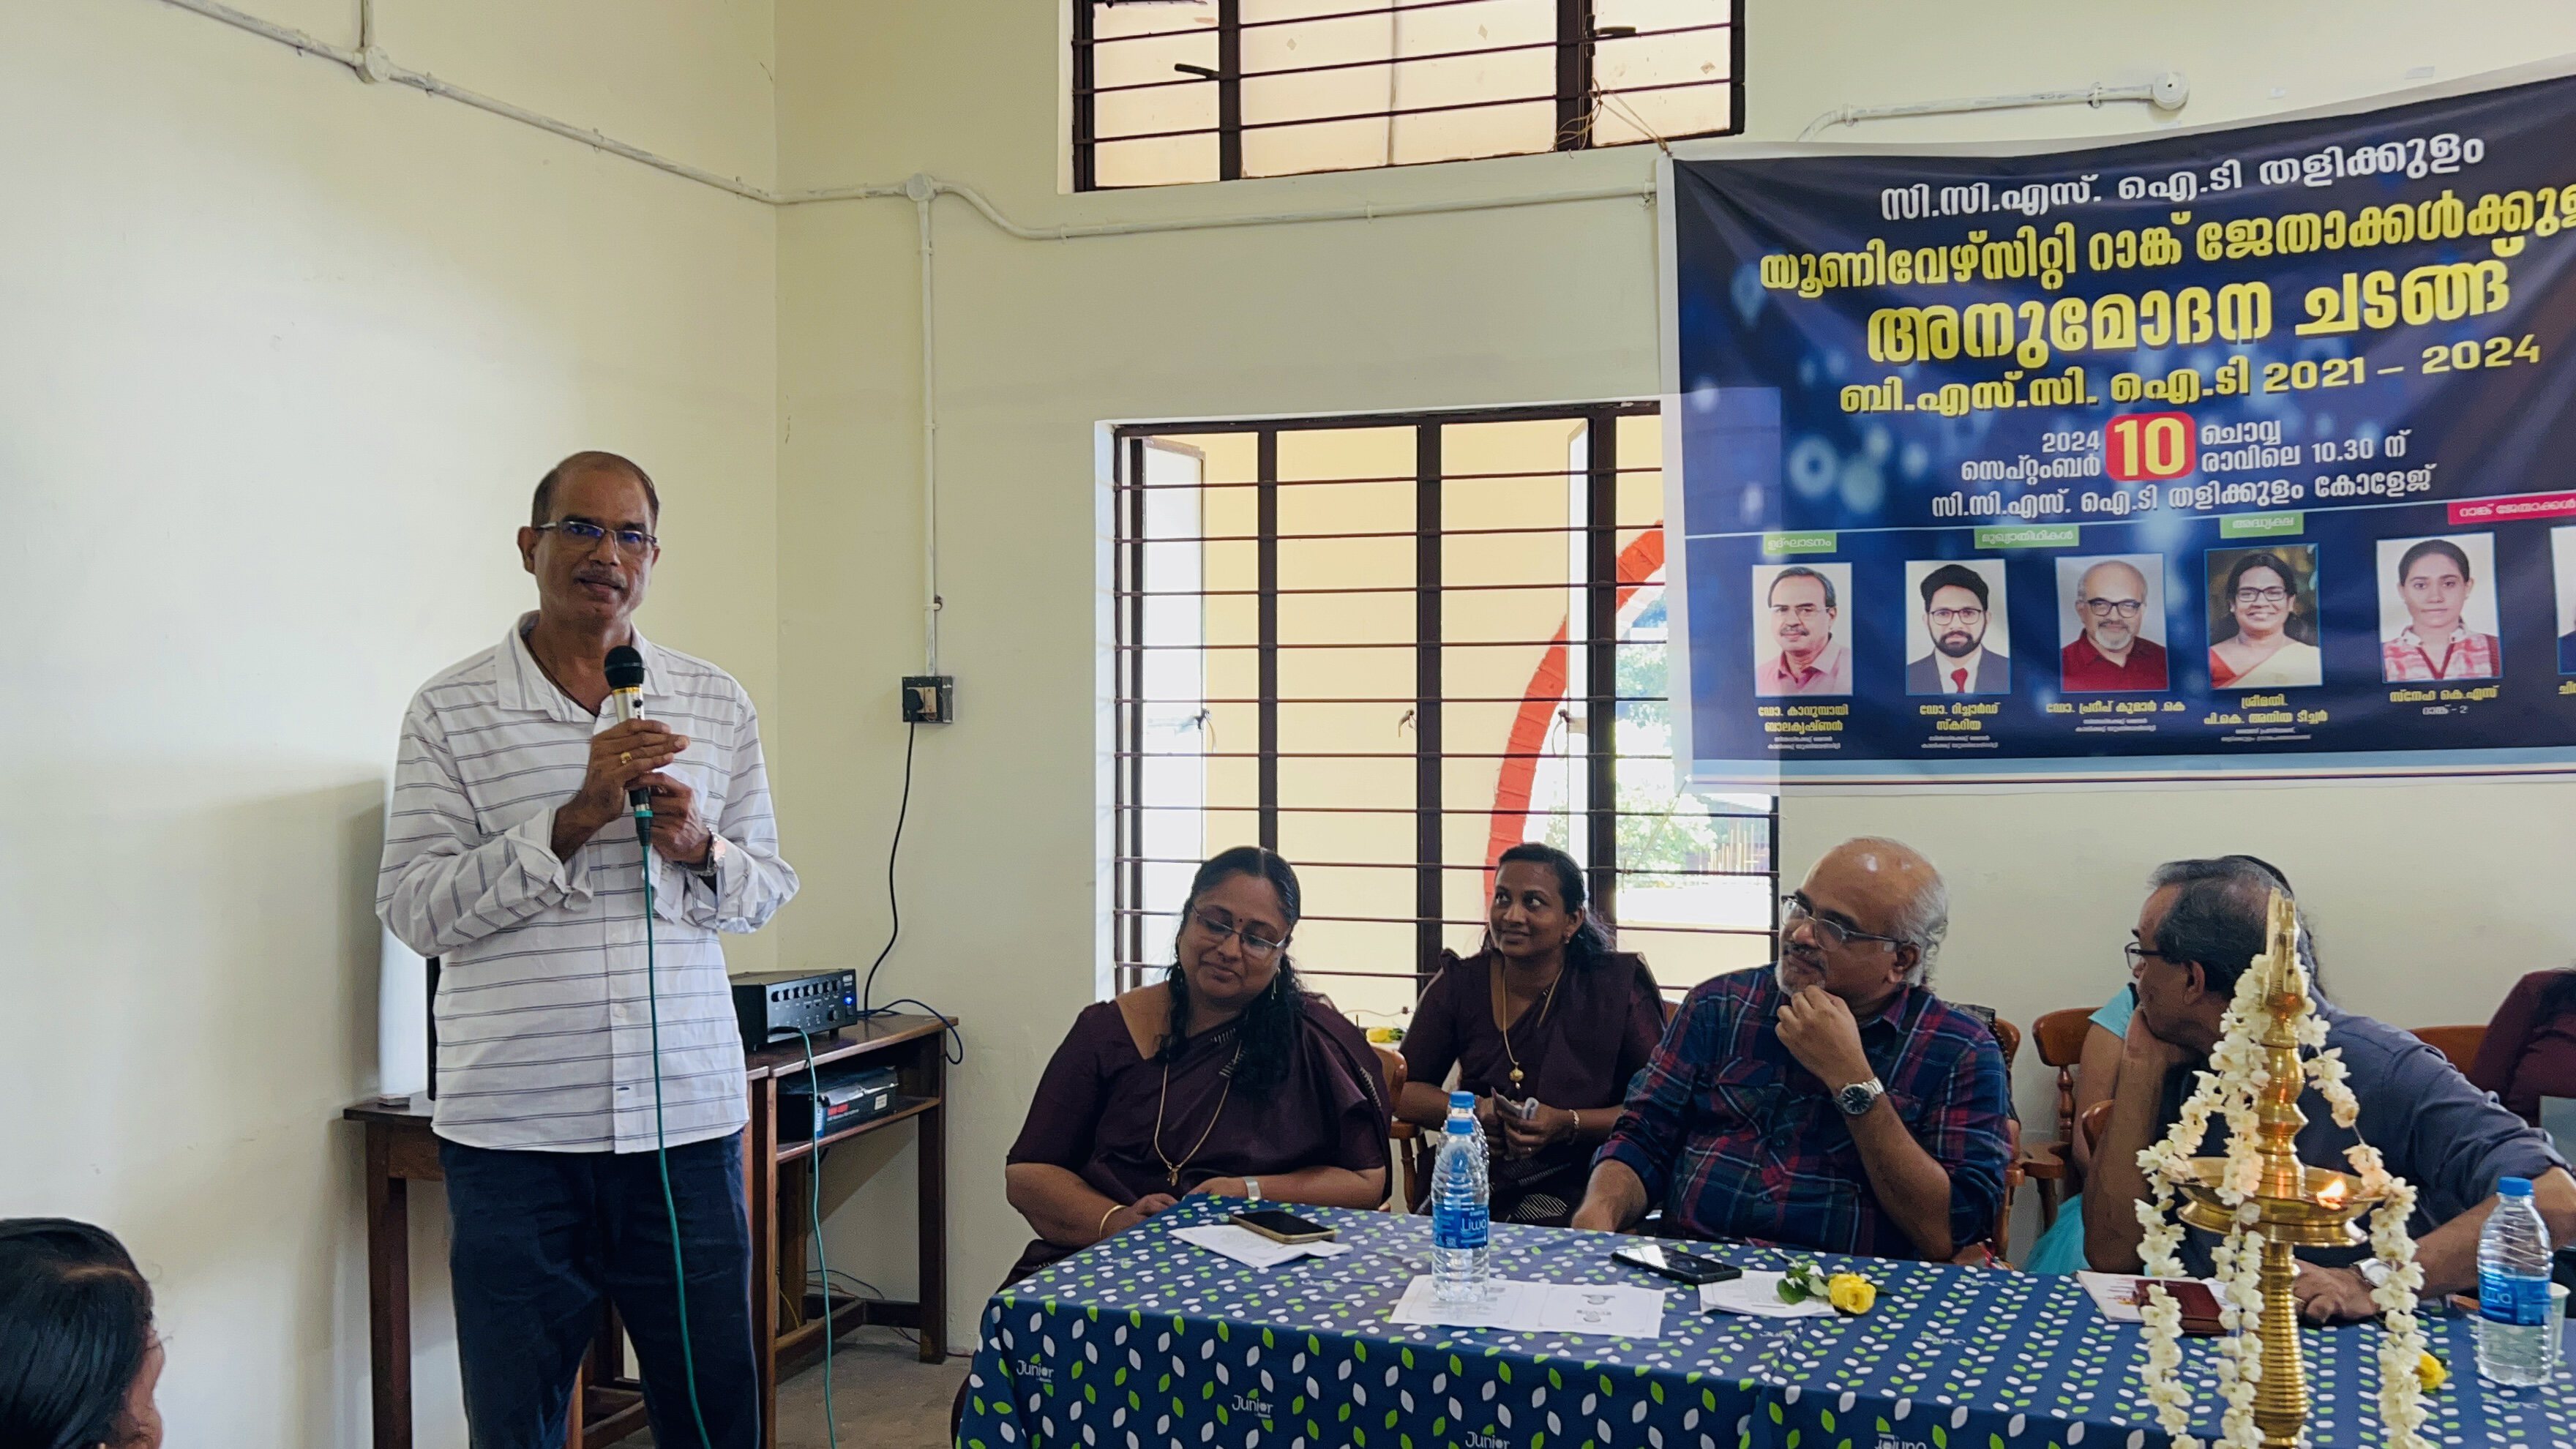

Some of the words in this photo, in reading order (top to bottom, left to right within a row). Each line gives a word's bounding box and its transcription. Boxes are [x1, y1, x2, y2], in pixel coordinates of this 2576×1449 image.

[1881, 173, 2103, 220] സി.സി.എസ്.
[2118, 158, 2242, 202] ഐ.ടി
[2258, 132, 2485, 187] തളിക്കുളം
[1759, 221, 2077, 299] യൂണിവേഴ്സിറ്റി
[2088, 210, 2193, 272] റാങ്ക്
[1867, 281, 2271, 369] അനുമോദന
[2295, 236, 2526, 340] ചടങ്ങ്
[2110, 354, 2250, 405] ഐ.ടി
[2262, 356, 2366, 394] 2021
[2421, 333, 2542, 375] 2024
[2042, 430, 2101, 454] 2024
[2113, 416, 2187, 478] 10
[2201, 419, 2283, 446] ചൊവ്വ
[2201, 445, 2302, 474] രാവിലെ
[2312, 438, 2375, 464] 10.30
[2384, 427, 2413, 460] ന്
[1961, 452, 2101, 486] സെപ്റ്റംബർ
[2081, 484, 2157, 516] ഐ.ടി
[2168, 479, 2304, 512] തളിക്കുളം
[2315, 463, 2438, 498] കോളേജ്
[1016, 1359, 1055, 1379] Junior
[1232, 1394, 1273, 1414] Junior
[1465, 1431, 1510, 1449] Junior
